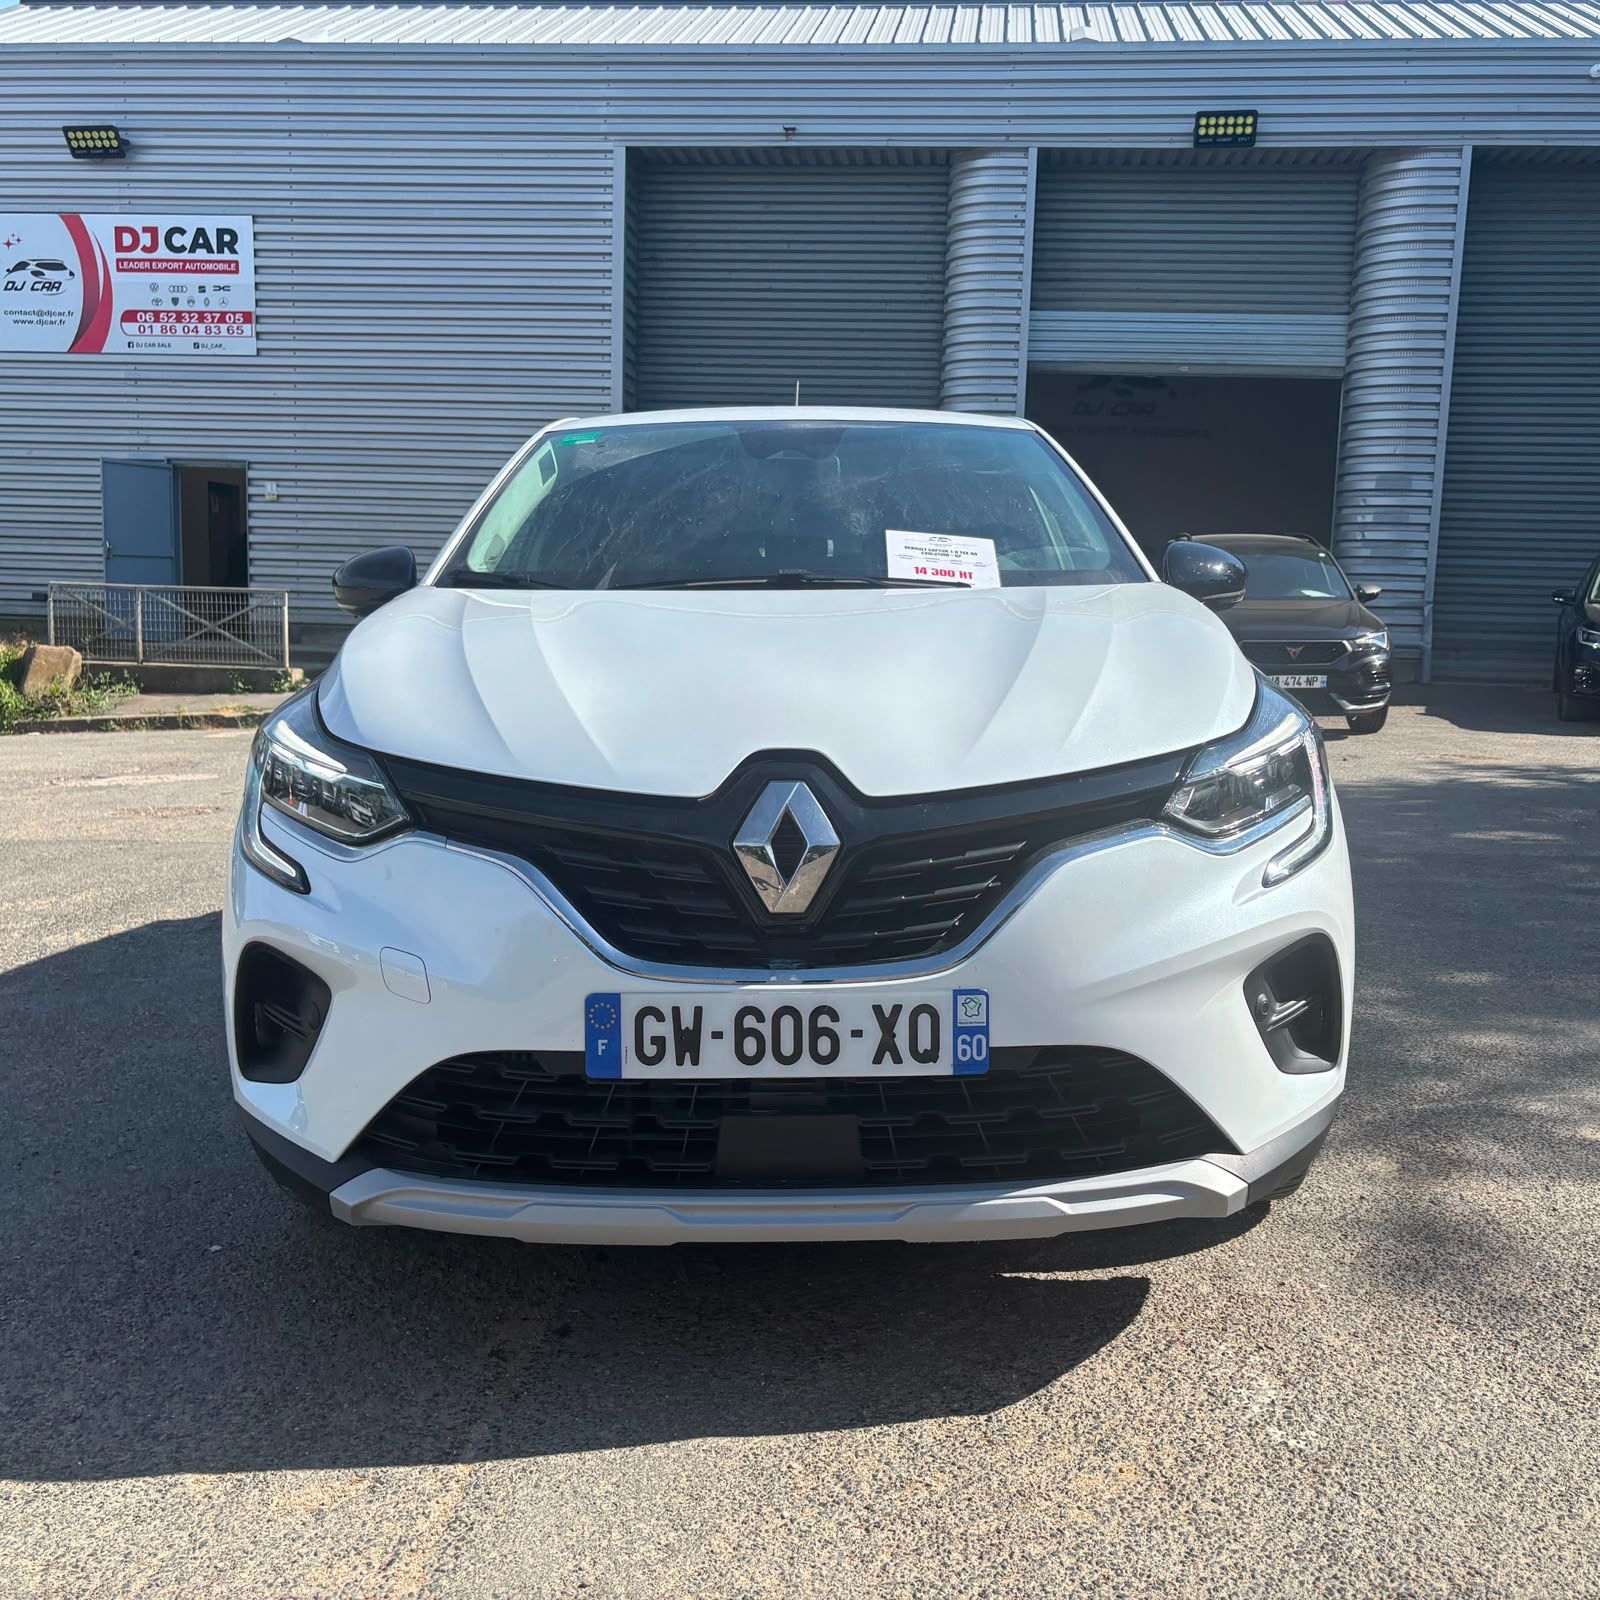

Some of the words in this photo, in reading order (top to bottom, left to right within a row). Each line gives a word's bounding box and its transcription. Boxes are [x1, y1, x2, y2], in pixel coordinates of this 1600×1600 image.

[114, 226, 159, 254] DJ
[164, 226, 239, 254] CAR
[119, 261, 151, 269] LEADER
[152, 262, 183, 270] EXPORT
[185, 263, 236, 271] AUTOMOBILE
[4, 281, 26, 291] DJ
[31, 281, 62, 292] CAR
[4, 309, 74, 317] contact@djcar.fr
[137, 312, 154, 322] 06
[160, 312, 177, 323] 52
[181, 313, 199, 323] 32
[204, 313, 221, 323] 37
[226, 313, 244, 323] 05
[138, 325, 154, 334] 01
[160, 325, 177, 335] 86
[182, 325, 200, 335] 04
[204, 325, 221, 335] 83
[226, 326, 244, 335] 65
[914, 566, 928, 575] 14
[931, 568, 956, 578] 300
[959, 570, 973, 580] HT
[1271, 676, 1319, 687] A-474-NP
[634, 1004, 940, 1066] GW-606-XQ
[597, 1039, 608, 1055] F
[957, 1034, 987, 1061] 60
